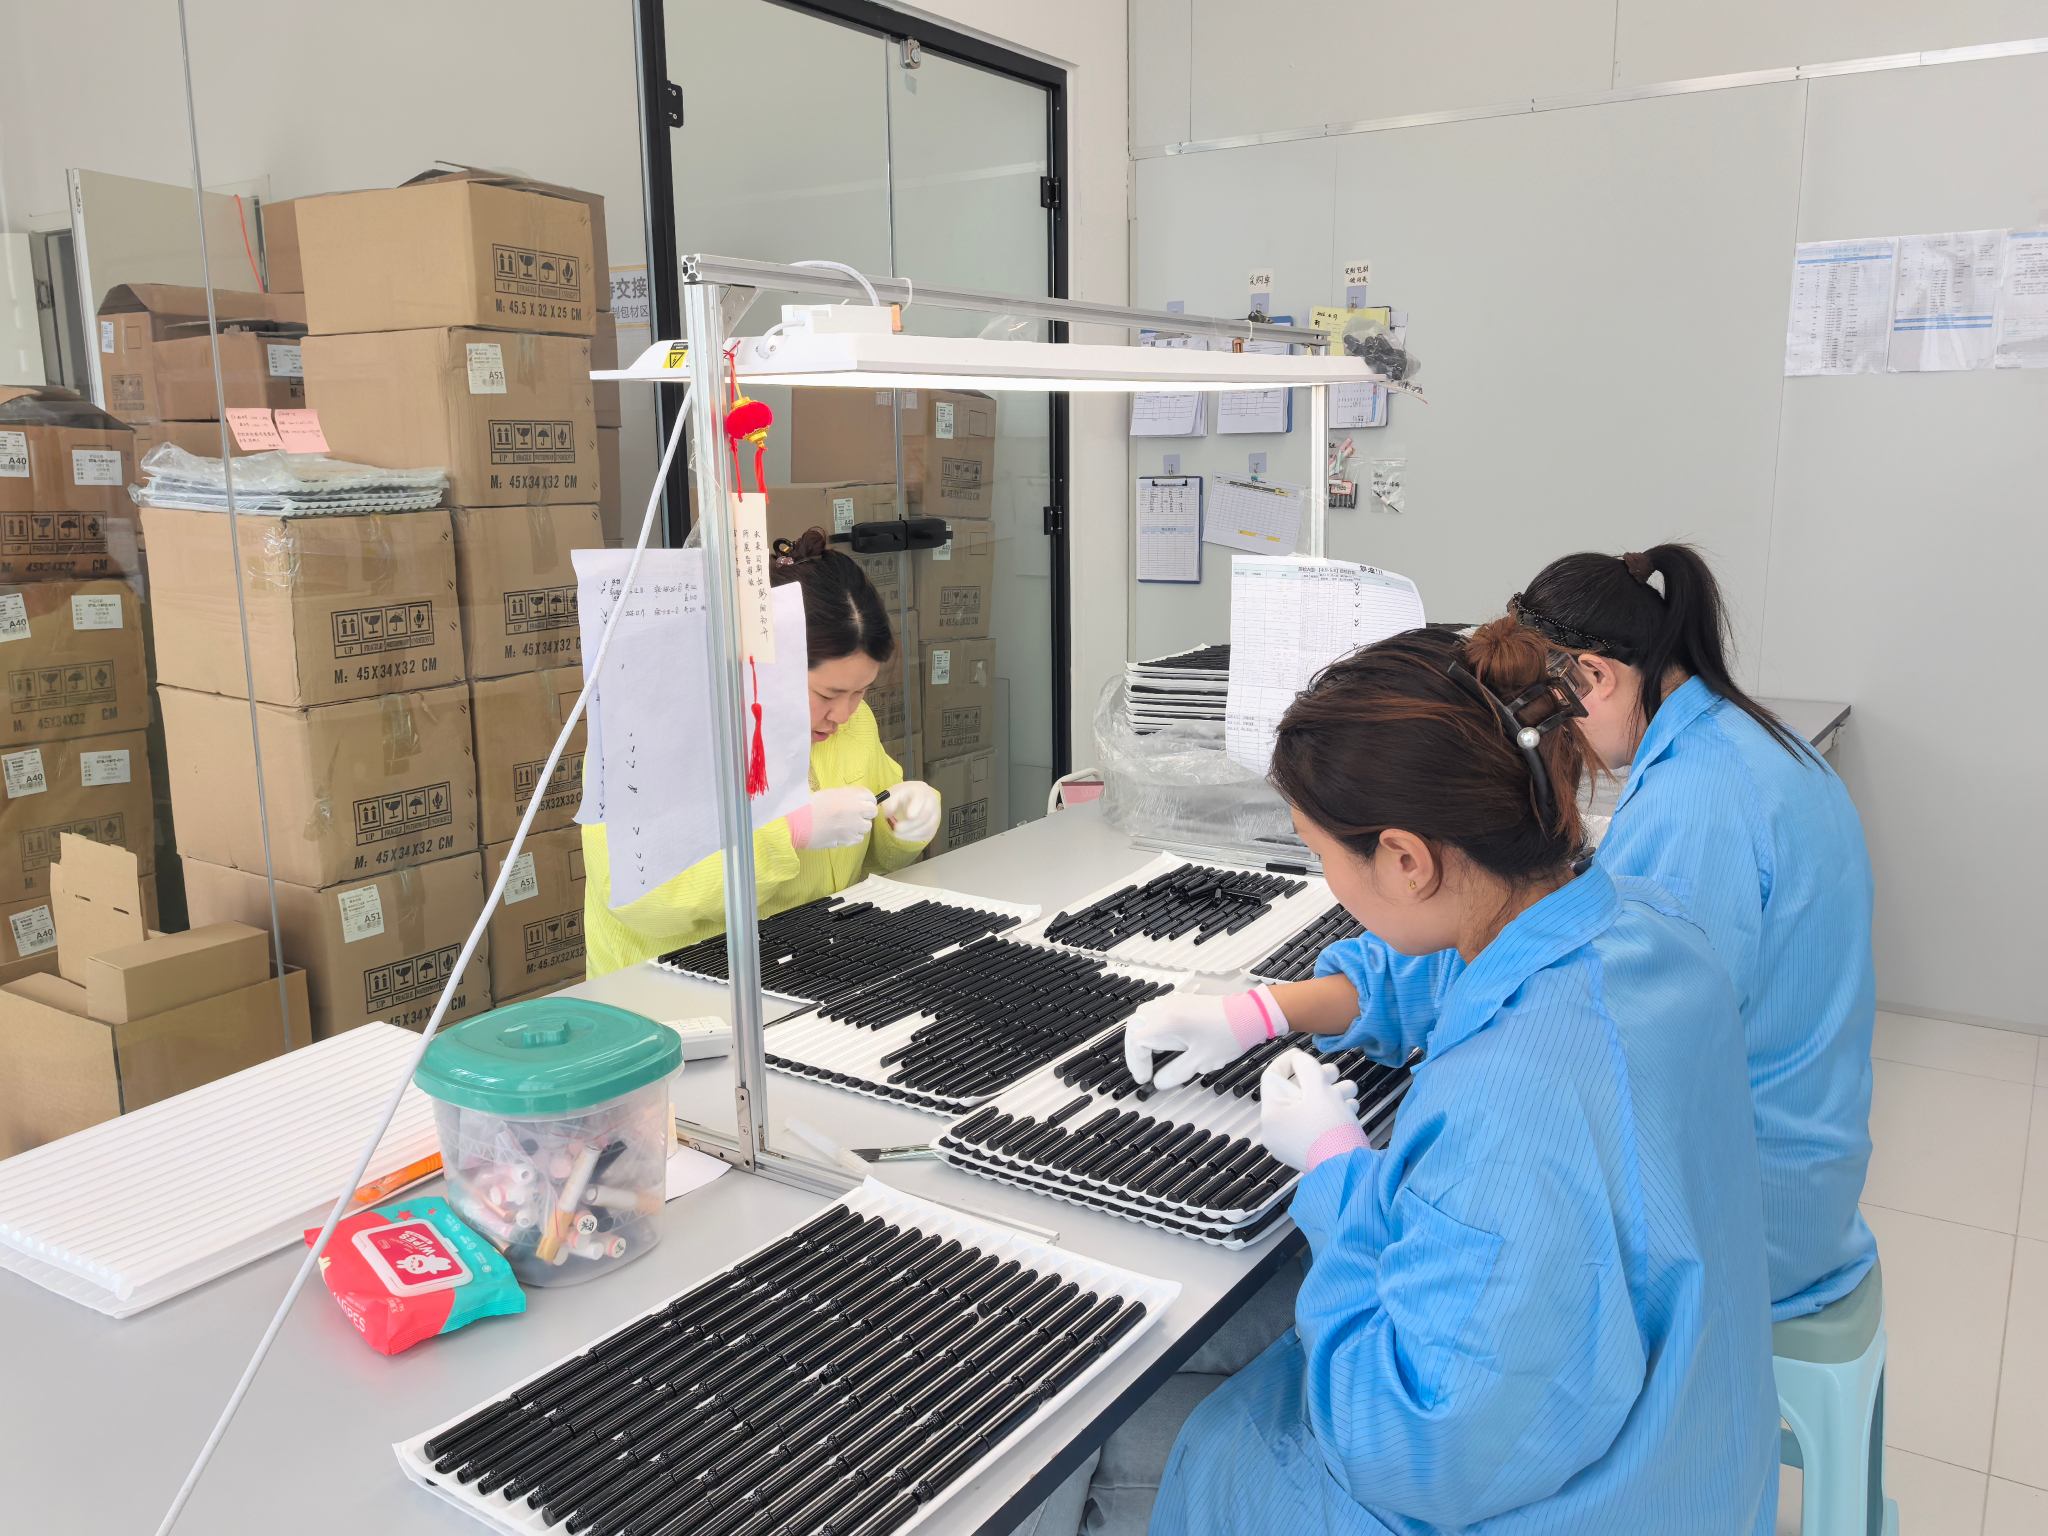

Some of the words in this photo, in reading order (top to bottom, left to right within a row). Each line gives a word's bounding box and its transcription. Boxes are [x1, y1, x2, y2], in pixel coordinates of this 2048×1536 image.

[509, 300, 527, 315] 45.5
[538, 303, 547, 317] 32
[557, 306, 567, 319] 25
[571, 307, 582, 321] CM
[489, 371, 504, 380] A51
[8, 457, 27, 466] A40
[509, 475, 560, 490] 45X34X32
[564, 475, 578, 489] CM
[9, 618, 27, 629] A40
[522, 638, 571, 656] 45X34X32
[334, 669, 348, 684] M:
[356, 659, 416, 681] 45X34X32
[421, 656, 437, 672] CM
[26, 773, 43, 783] A40
[354, 855, 368, 870] M:
[376, 839, 433, 865] 45X34X32
[438, 834, 454, 850] CM
[520, 877, 535, 889] A51
[364, 911, 381, 923] A51
[36, 928, 53, 940] A40
[451, 994, 466, 1011] CM
[398, 1232, 437, 1257] WIPES
